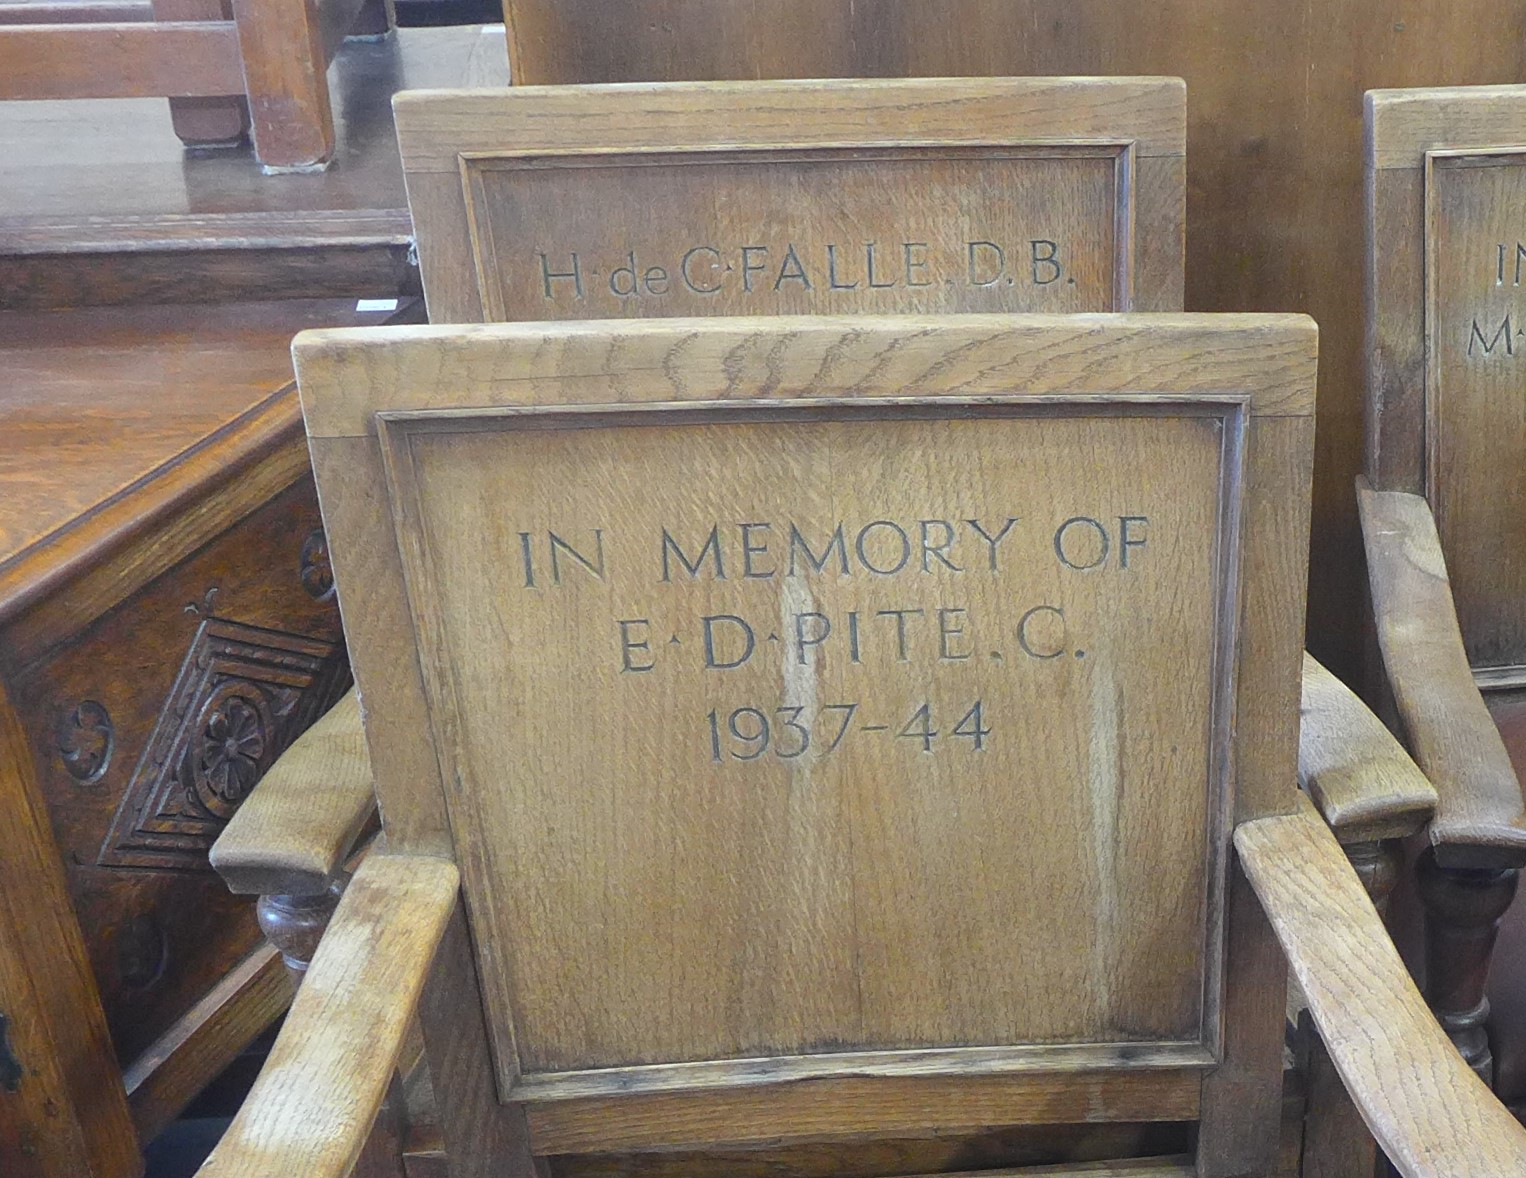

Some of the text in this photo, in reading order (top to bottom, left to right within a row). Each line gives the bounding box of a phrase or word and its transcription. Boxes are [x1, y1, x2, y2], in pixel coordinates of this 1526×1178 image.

[517, 515, 1148, 588] IN MEMORY OF
[706, 699, 993, 763] 1937-44
